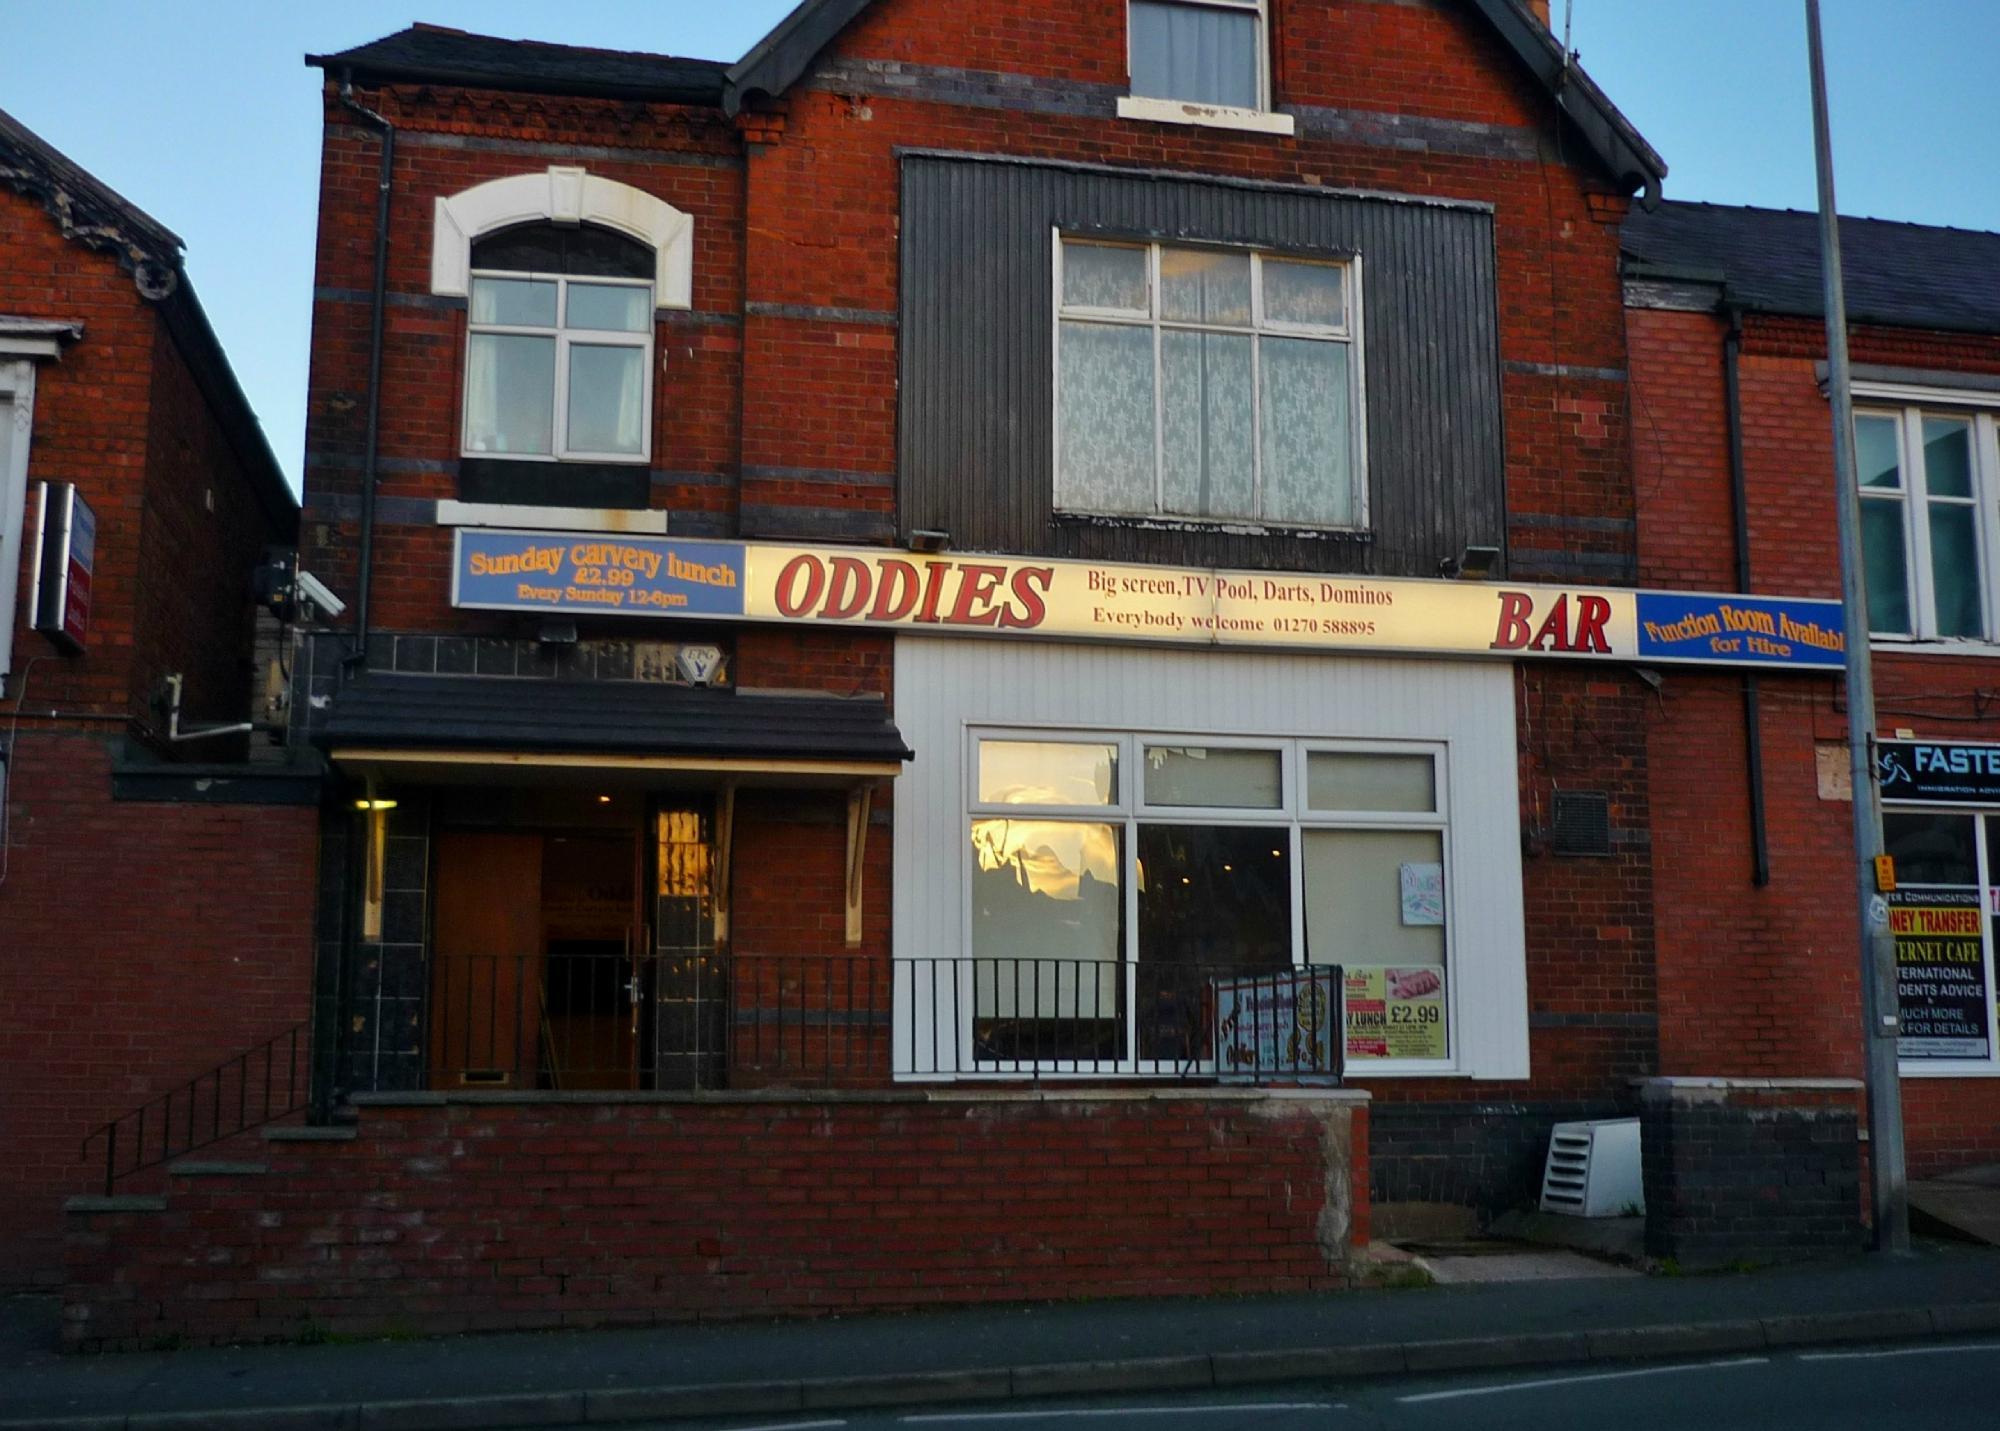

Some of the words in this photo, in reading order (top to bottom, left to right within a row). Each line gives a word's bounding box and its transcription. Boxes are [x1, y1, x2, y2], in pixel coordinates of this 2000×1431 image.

[470, 546, 565, 575] Sunday
[570, 544, 662, 579] carvery
[668, 552, 736, 587] lunch
[574, 568, 634, 587] £2.99
[1088, 570, 1117, 599] Big
[1216, 578, 1257, 601] Pool,
[1264, 580, 1315, 606] Darts,
[1320, 583, 1393, 606] Dominos
[517, 584, 563, 604] Every
[566, 587, 624, 607] Sunday
[775, 554, 1054, 628] ODDIES
[1094, 607, 1185, 630] Everybody
[1191, 614, 1264, 632] welcome
[1274, 618, 1317, 633] 01270
[1322, 620, 1375, 635] 588895
[1489, 591, 1612, 654] BAR
[1643, 611, 1721, 643] Function
[1721, 604, 1775, 634] Room
[1710, 637, 1739, 654] for
[1747, 638, 1791, 657] Hire
[1914, 746, 2000, 774] FASTE
[1889, 909, 1915, 932] NEY
[1918, 910, 1979, 933] TRANSFER
[1896, 942, 1942, 962] ERNET
[1947, 943, 1979, 962] CAFE
[1940, 985, 1983, 997] ADVICE
[1355, 1011, 1387, 1025] LUNCH
[1391, 1006, 1439, 1024] £2.99
[1932, 1008, 1963, 1019] MORE
[1908, 1022, 1930, 1034] FOR
[1934, 1022, 1979, 1034] DETAILS
